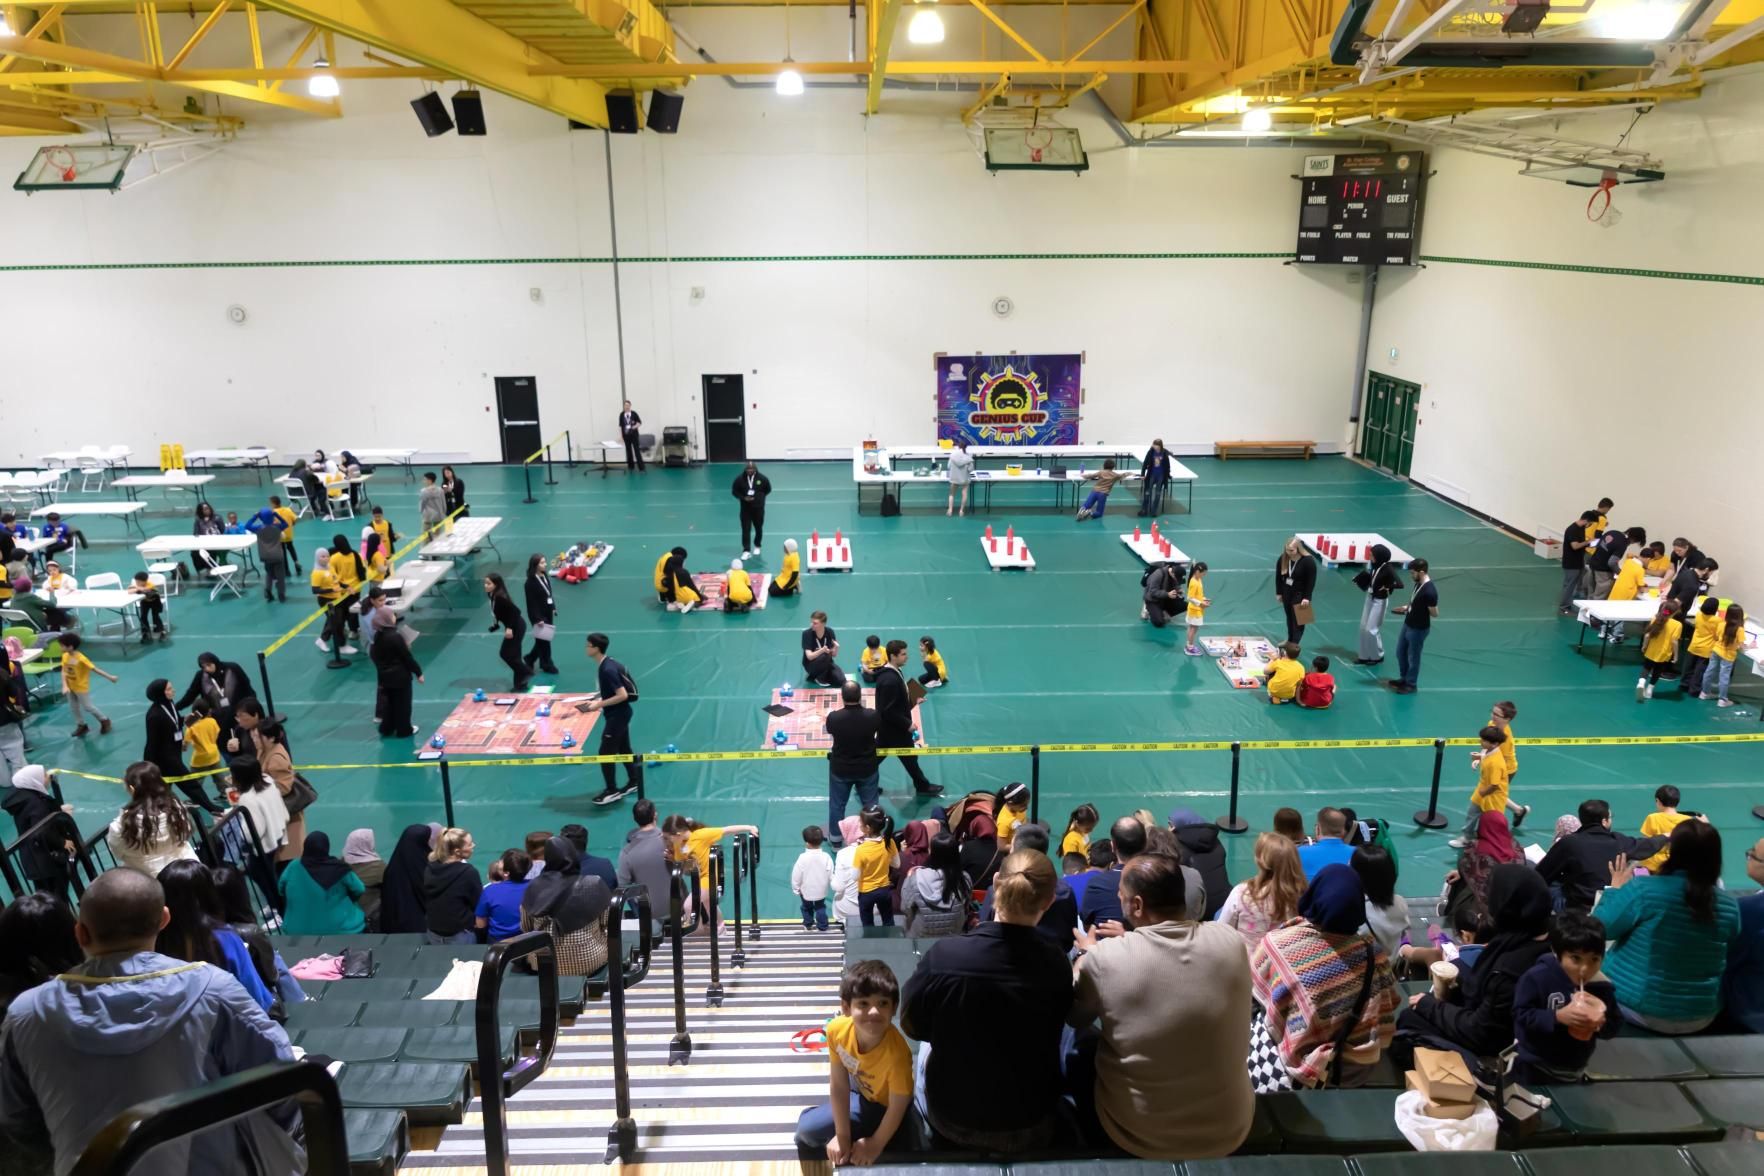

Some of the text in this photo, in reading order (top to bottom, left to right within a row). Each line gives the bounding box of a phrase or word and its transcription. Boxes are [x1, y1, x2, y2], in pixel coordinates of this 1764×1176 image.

[1310, 159, 1329, 169] SAINTS
[1343, 179, 1381, 198] 11:11
[1308, 196, 1327, 204] HOME
[1386, 194, 1410, 203] GUEST
[971, 413, 1046, 424] GENIUS CUP
